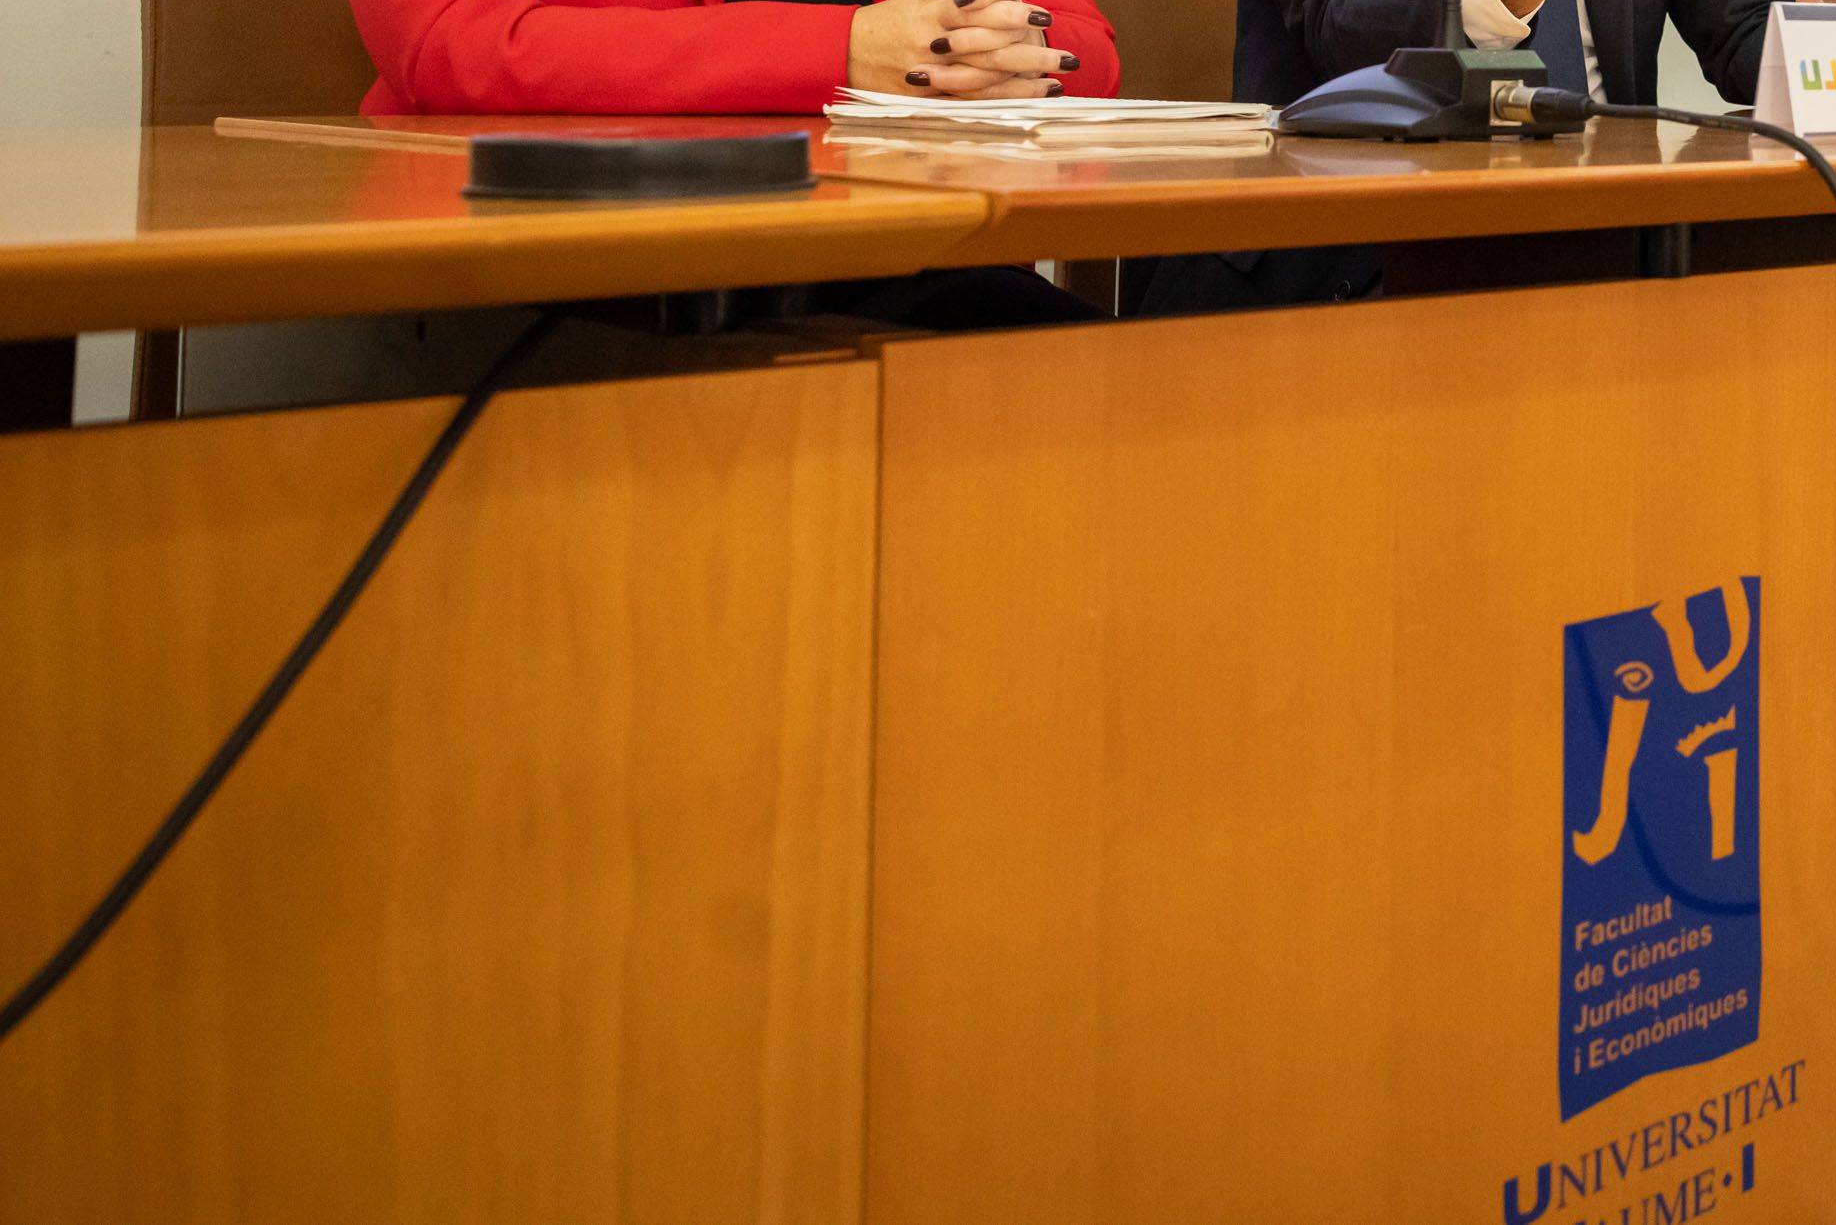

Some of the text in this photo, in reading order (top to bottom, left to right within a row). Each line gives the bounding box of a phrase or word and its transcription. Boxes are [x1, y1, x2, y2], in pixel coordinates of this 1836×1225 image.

[1575, 893, 1672, 951] Facultat
[1574, 923, 1713, 993] de Ciències
[1573, 986, 1748, 1075] i Econòmiques
[1574, 968, 1701, 1034] Jurídiques
[1503, 1059, 1806, 1225] UNIVERSITAT
